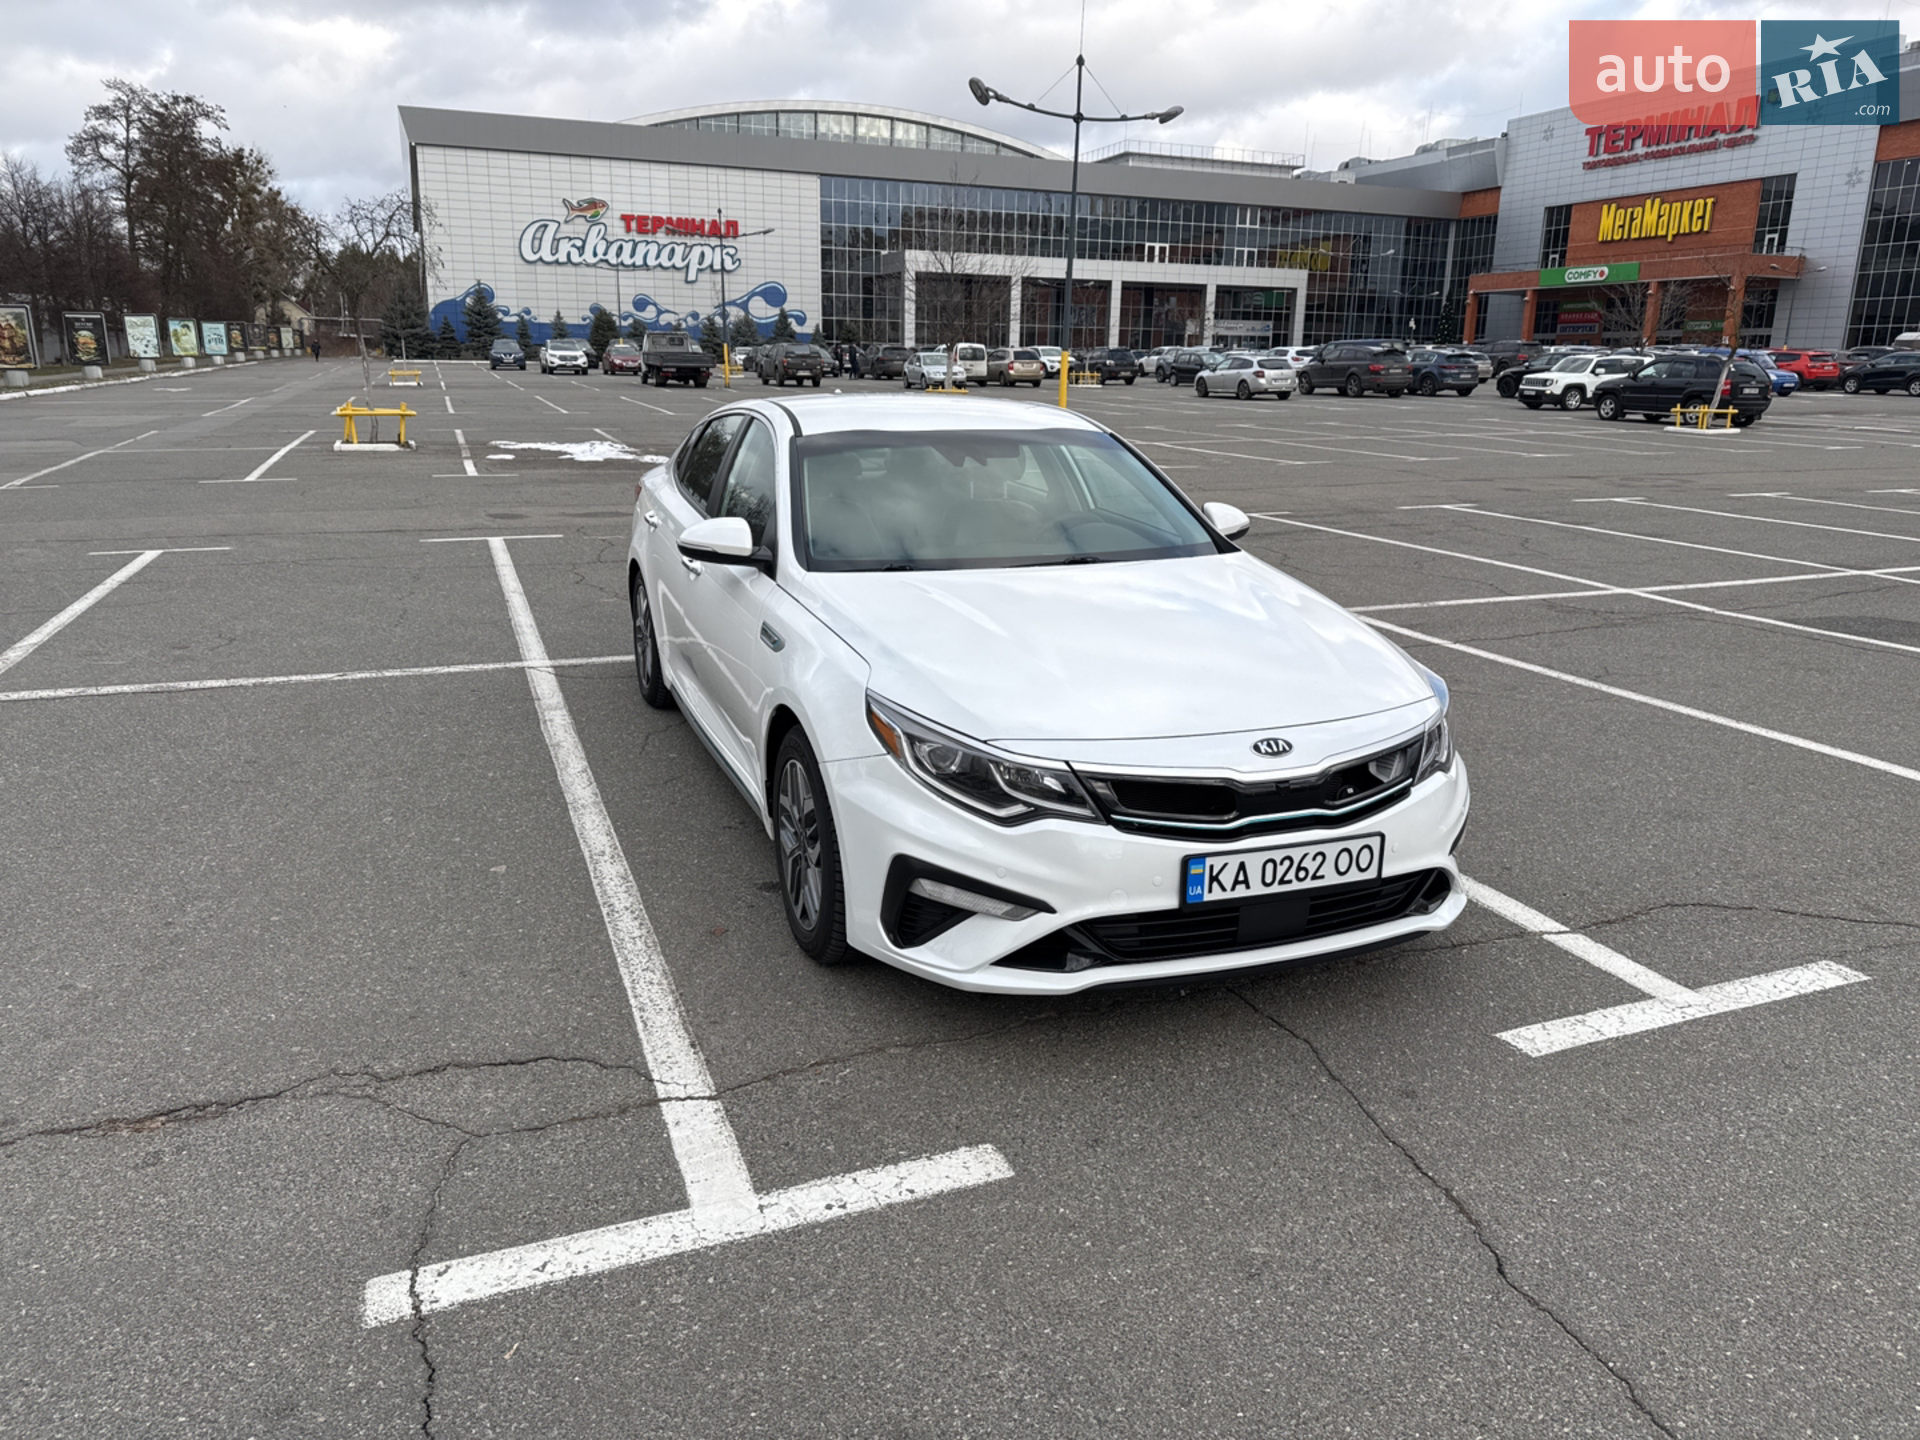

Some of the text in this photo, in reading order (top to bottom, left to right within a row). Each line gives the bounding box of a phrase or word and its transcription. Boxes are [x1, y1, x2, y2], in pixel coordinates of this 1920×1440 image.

[1584, 94, 1761, 158] ТЕРМІНАЛ
[620, 213, 739, 238] ТЕРМІНАЛ
[1597, 197, 1715, 242] МегаМаркет
[519, 218, 742, 283] Аквапарк
[1566, 269, 1599, 281] COMFY
[1257, 739, 1290, 754] KIA
[1207, 861, 1251, 894] KA
[1261, 851, 1327, 887] 0262
[1188, 886, 1202, 896] UA
